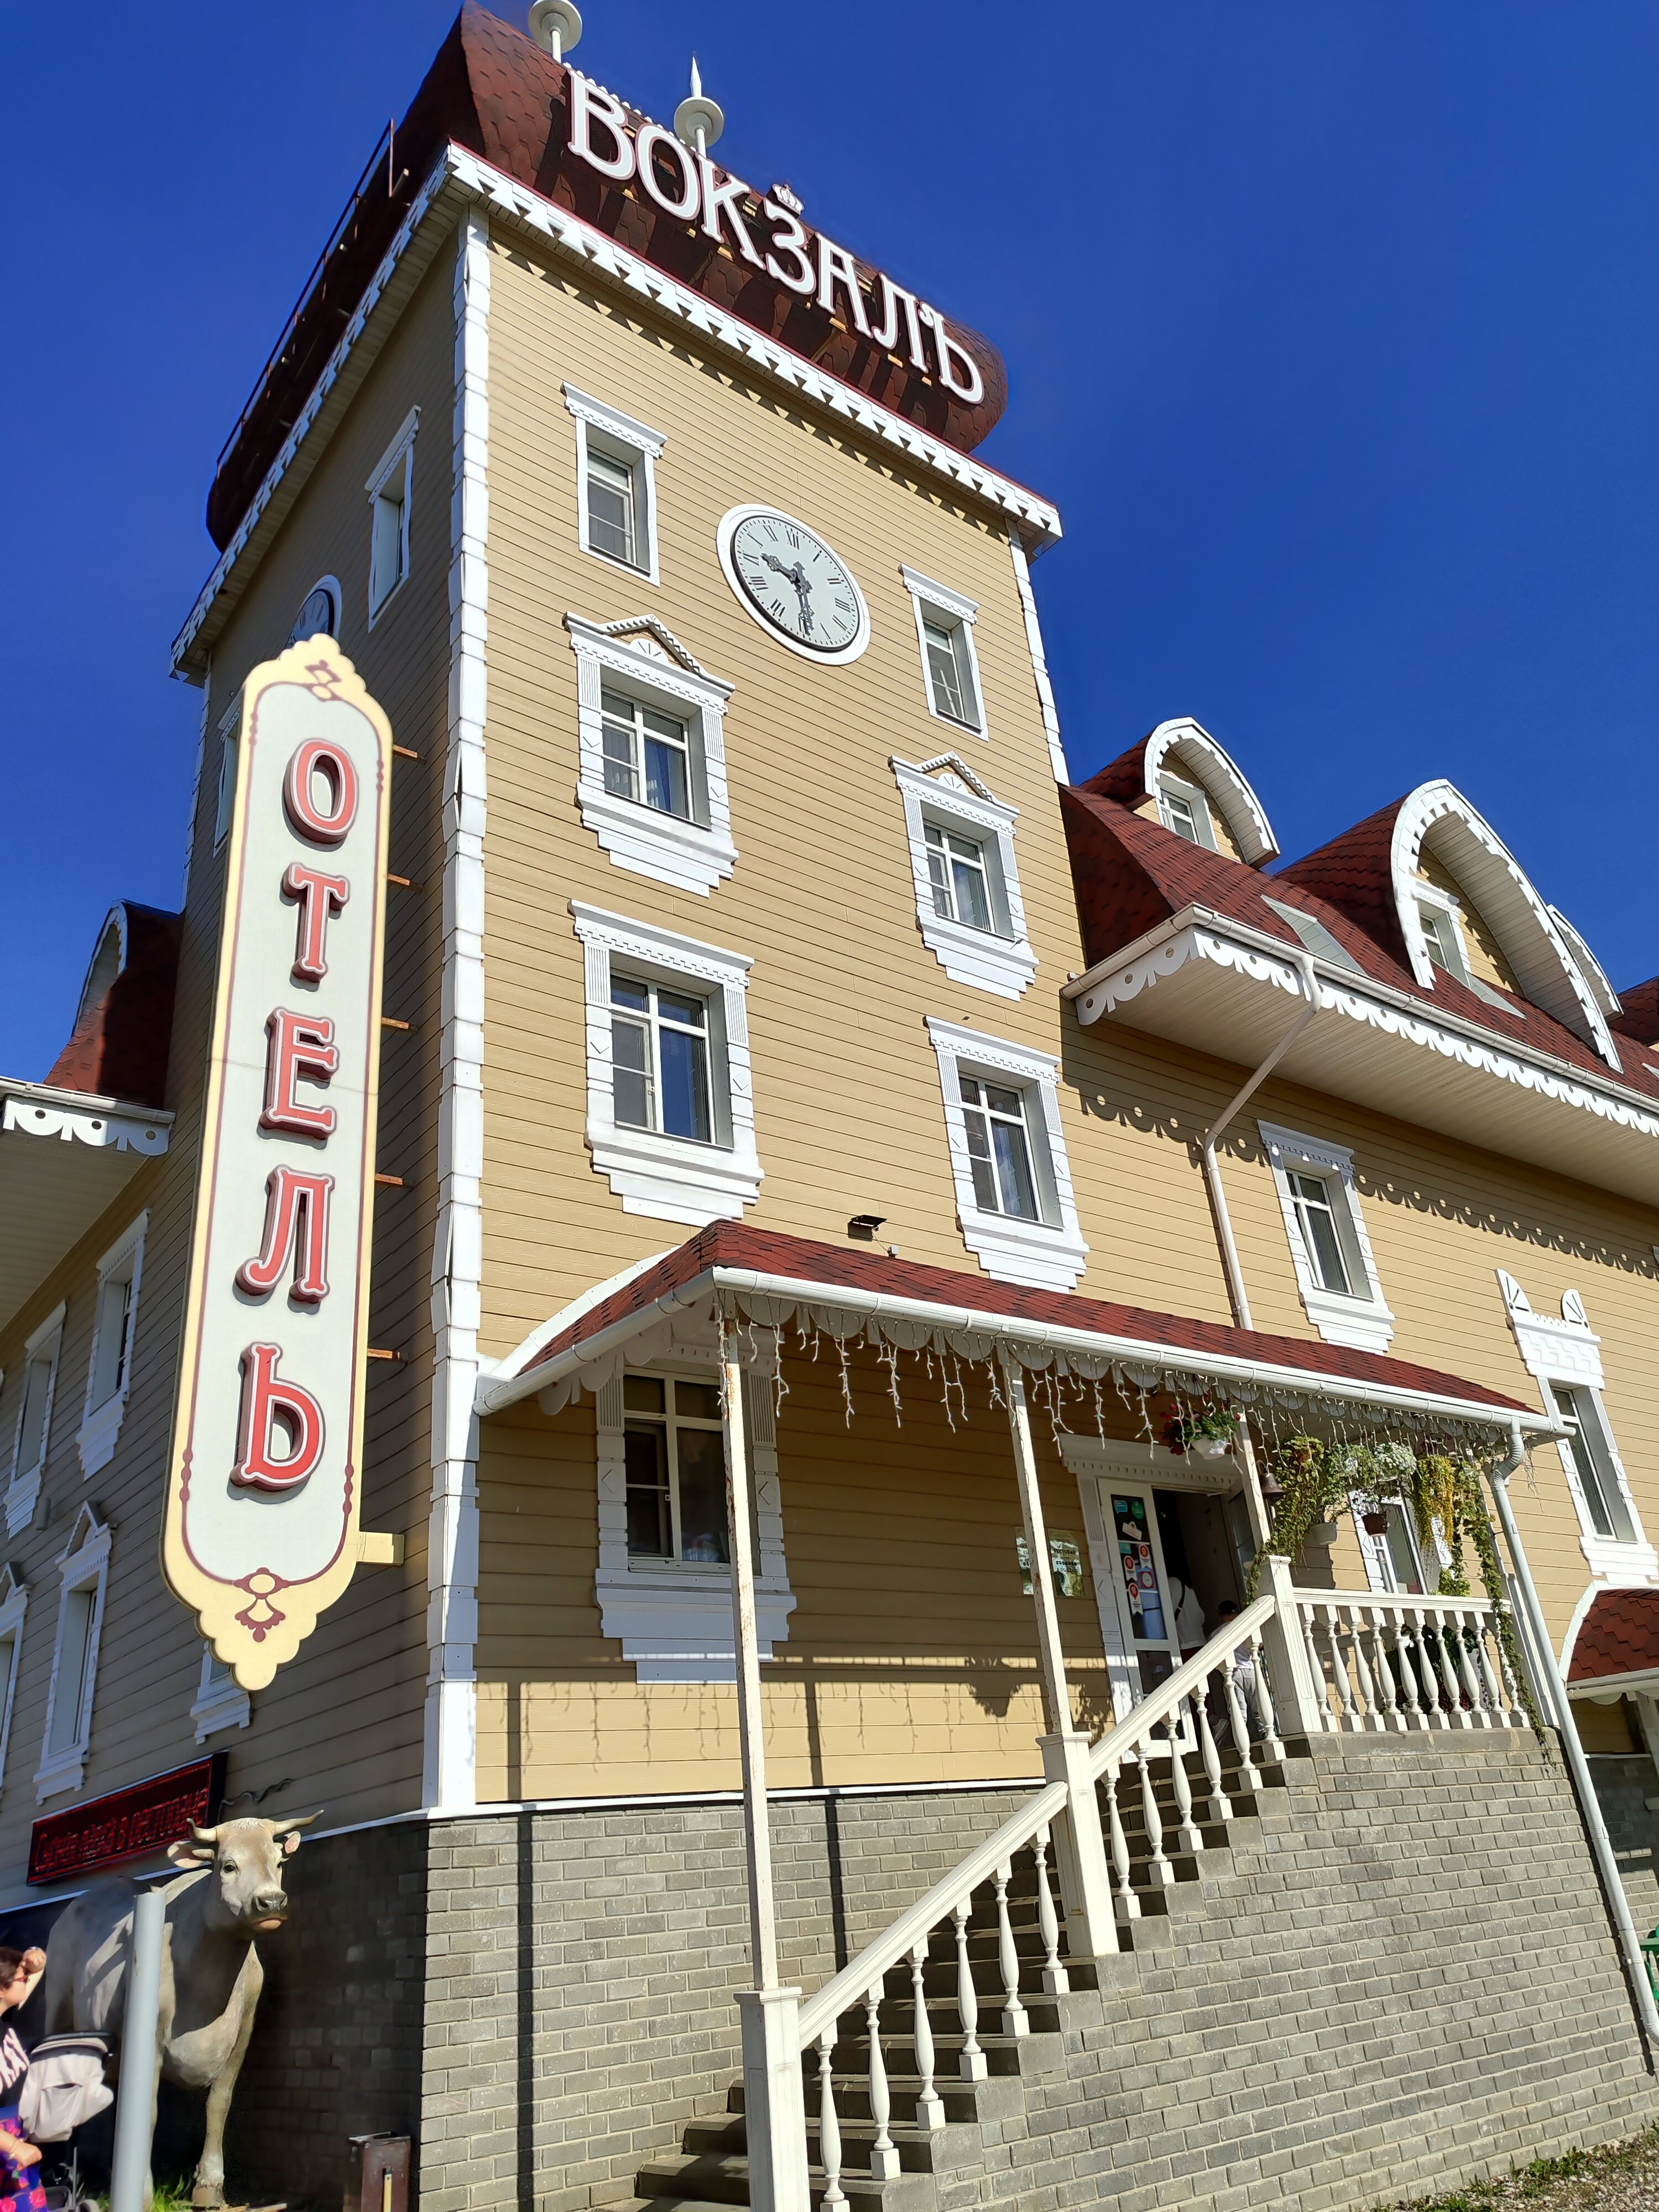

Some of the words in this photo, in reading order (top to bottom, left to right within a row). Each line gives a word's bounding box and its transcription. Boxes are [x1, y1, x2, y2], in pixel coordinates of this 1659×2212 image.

[567, 67, 985, 404] ВОКЗАЛЪ
[747, 531, 763, 549] X
[763, 525, 779, 542] XI
[786, 530, 800, 550] XII
[834, 597, 851, 613] III
[232, 738, 359, 1490] ОТЕЛЬ
[0, 2027, 30, 2095] KAY
